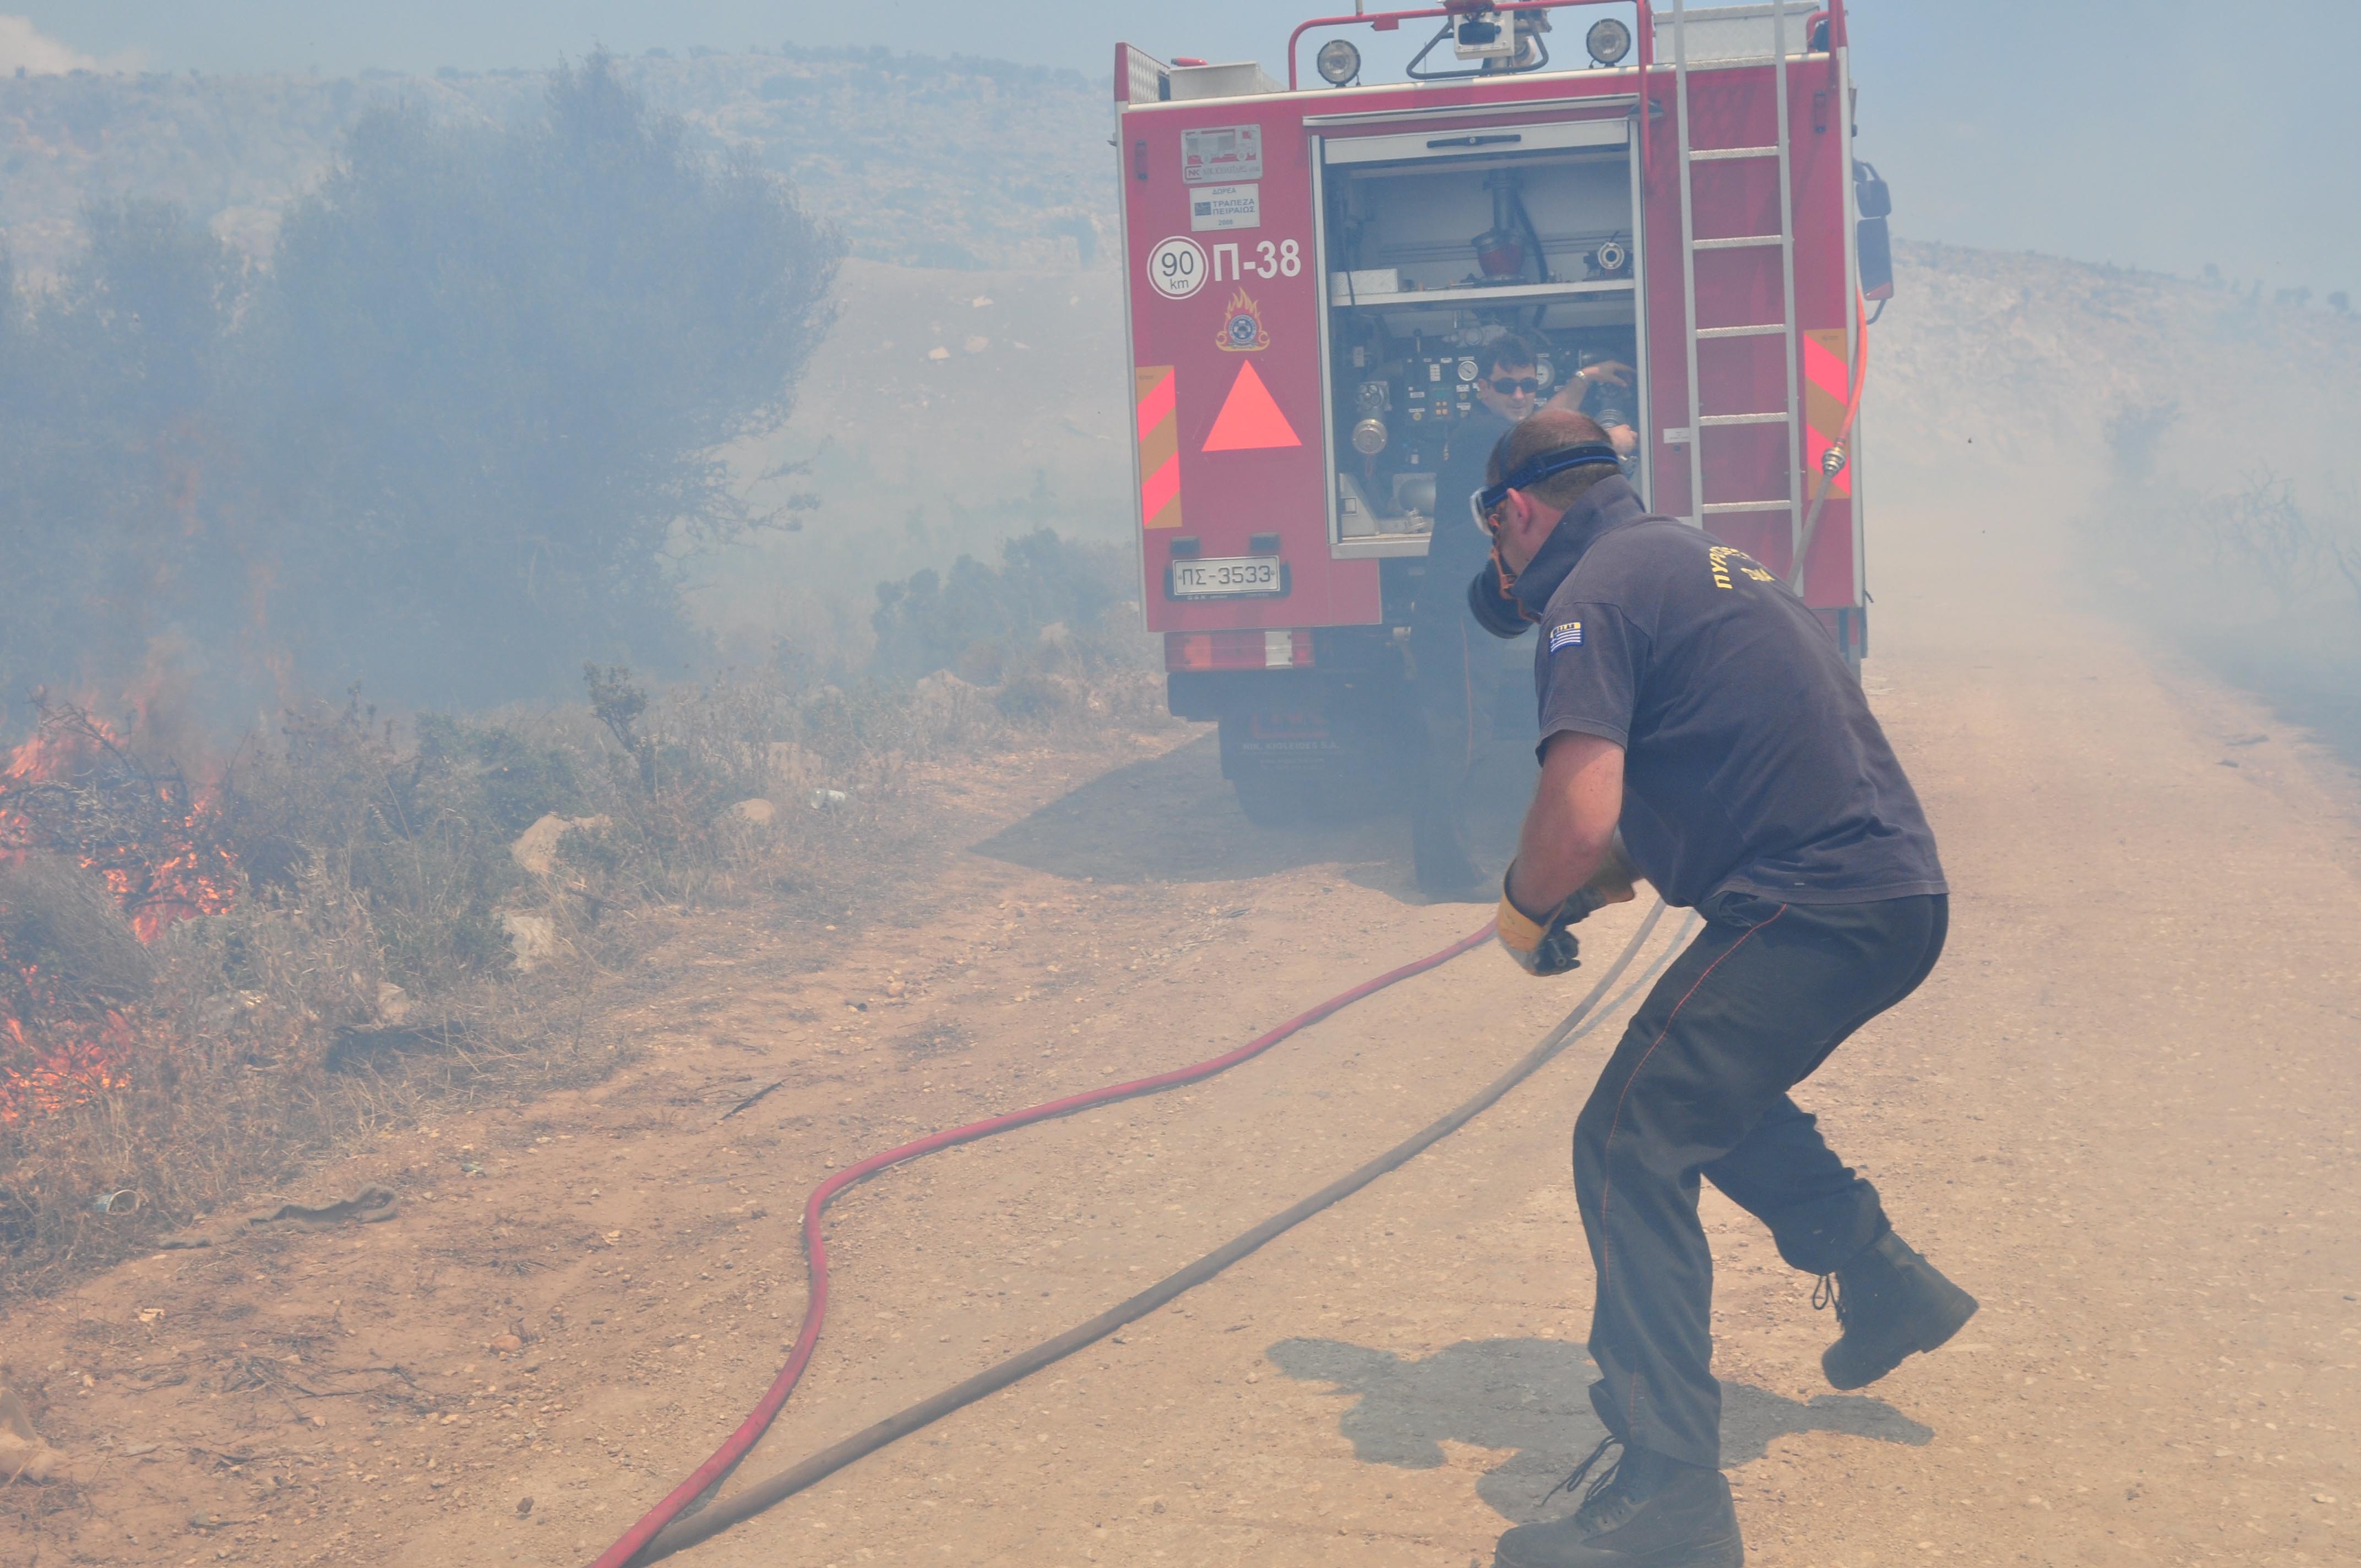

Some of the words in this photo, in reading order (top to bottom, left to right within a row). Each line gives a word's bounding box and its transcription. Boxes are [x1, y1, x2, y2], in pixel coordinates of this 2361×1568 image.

[1212, 198, 1255, 206] ΤΡΑΠΕΖΑ
[1212, 206, 1255, 215] ΠΕΙΡΑΙΩΣ
[1161, 251, 1194, 277] 90
[1213, 239, 1302, 282] Π-38
[1169, 277, 1189, 291] km
[1182, 565, 1271, 585] ΠΣ-3533
